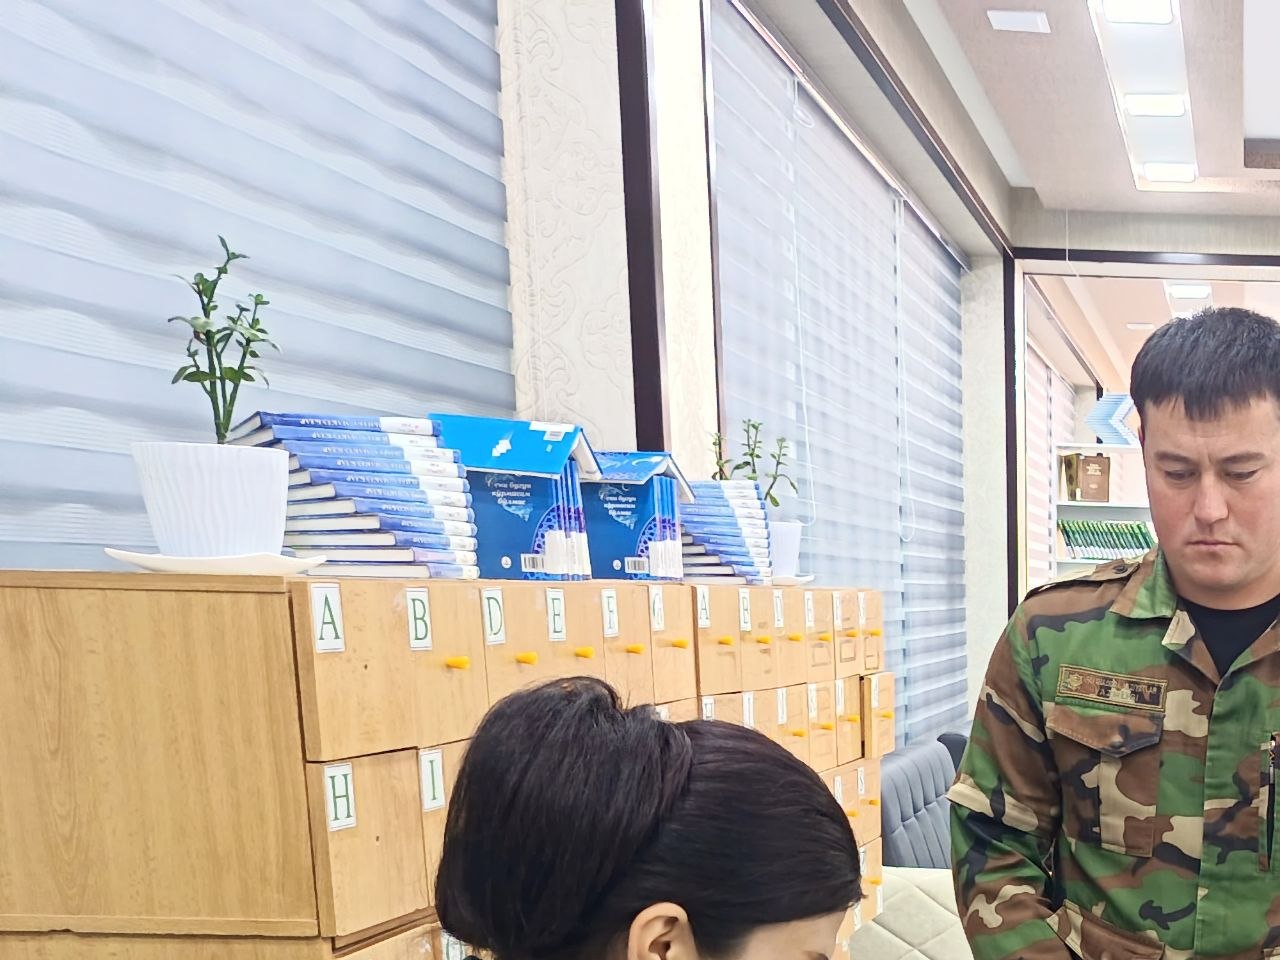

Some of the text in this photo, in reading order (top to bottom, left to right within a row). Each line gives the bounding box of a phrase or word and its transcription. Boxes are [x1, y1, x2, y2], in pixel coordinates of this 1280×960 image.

[318, 594, 341, 641] A
[410, 598, 429, 641] B
[487, 597, 504, 636] D
[552, 597, 565, 634] E
[605, 595, 617, 630] F
[329, 773, 353, 821] H
[428, 759, 439, 801] I
